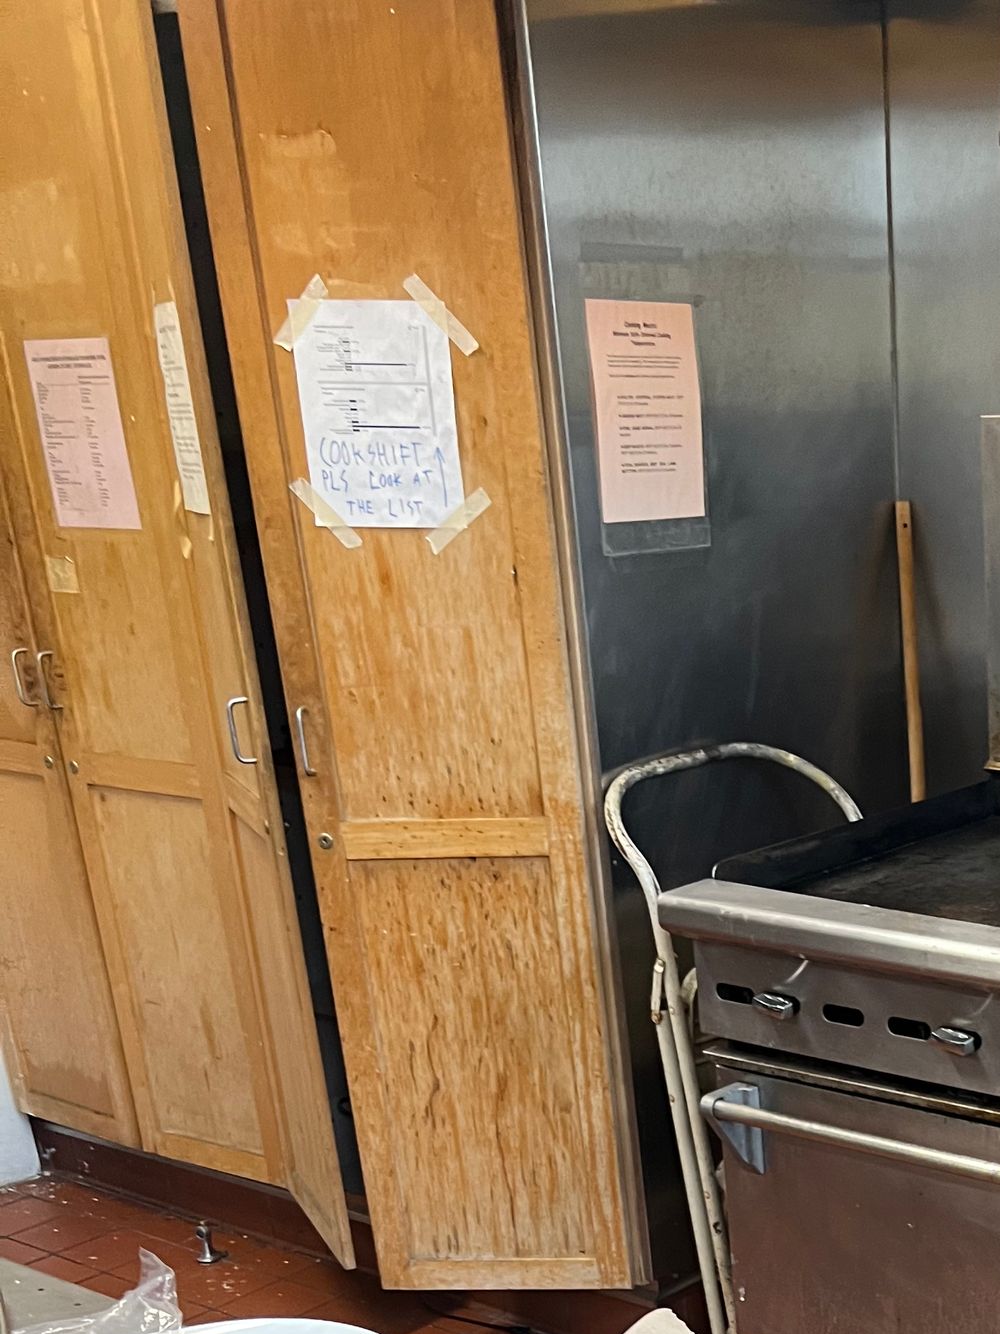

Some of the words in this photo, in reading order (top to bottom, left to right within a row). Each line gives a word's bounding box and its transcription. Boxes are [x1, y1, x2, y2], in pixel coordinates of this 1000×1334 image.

[322, 470, 348, 492] PLS
[369, 471, 401, 489] LOOK
[413, 470, 432, 487] AT
[346, 499, 374, 515] THE
[388, 498, 423, 517] LIST
